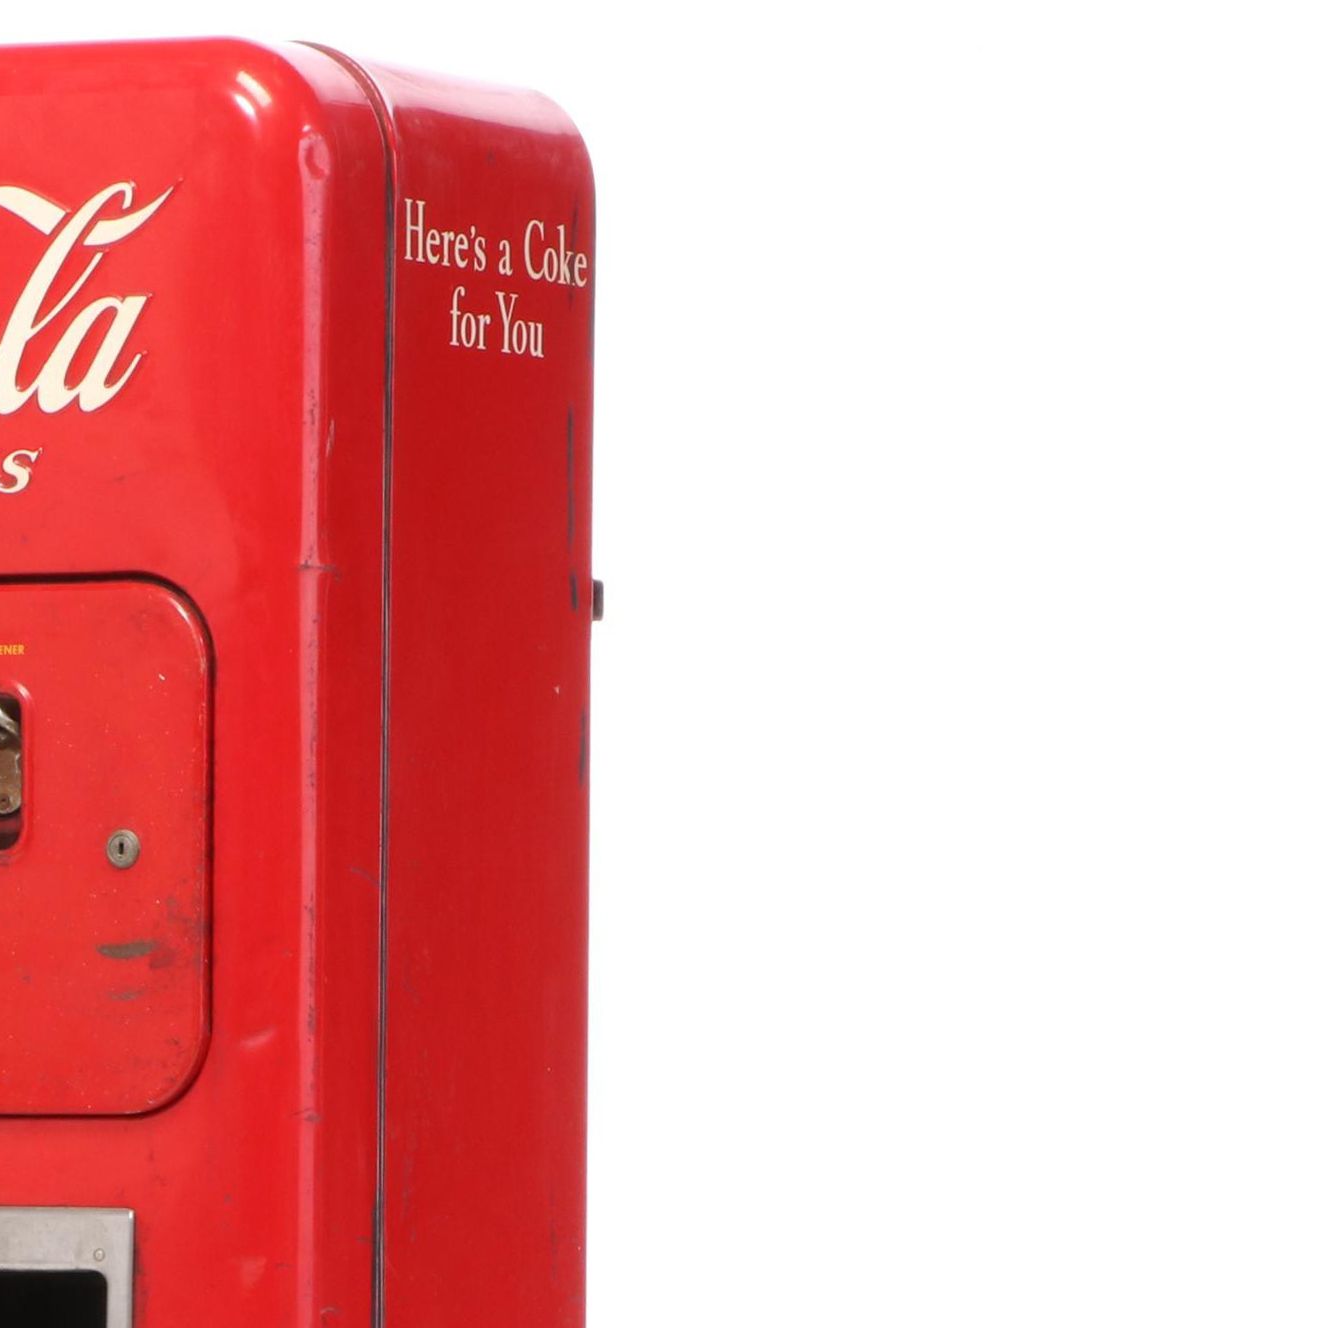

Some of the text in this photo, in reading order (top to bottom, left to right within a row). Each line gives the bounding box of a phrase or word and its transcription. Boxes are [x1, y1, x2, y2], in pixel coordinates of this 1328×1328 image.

[404, 198, 587, 287] Here's a Coke
[450, 286, 544, 358] for You
